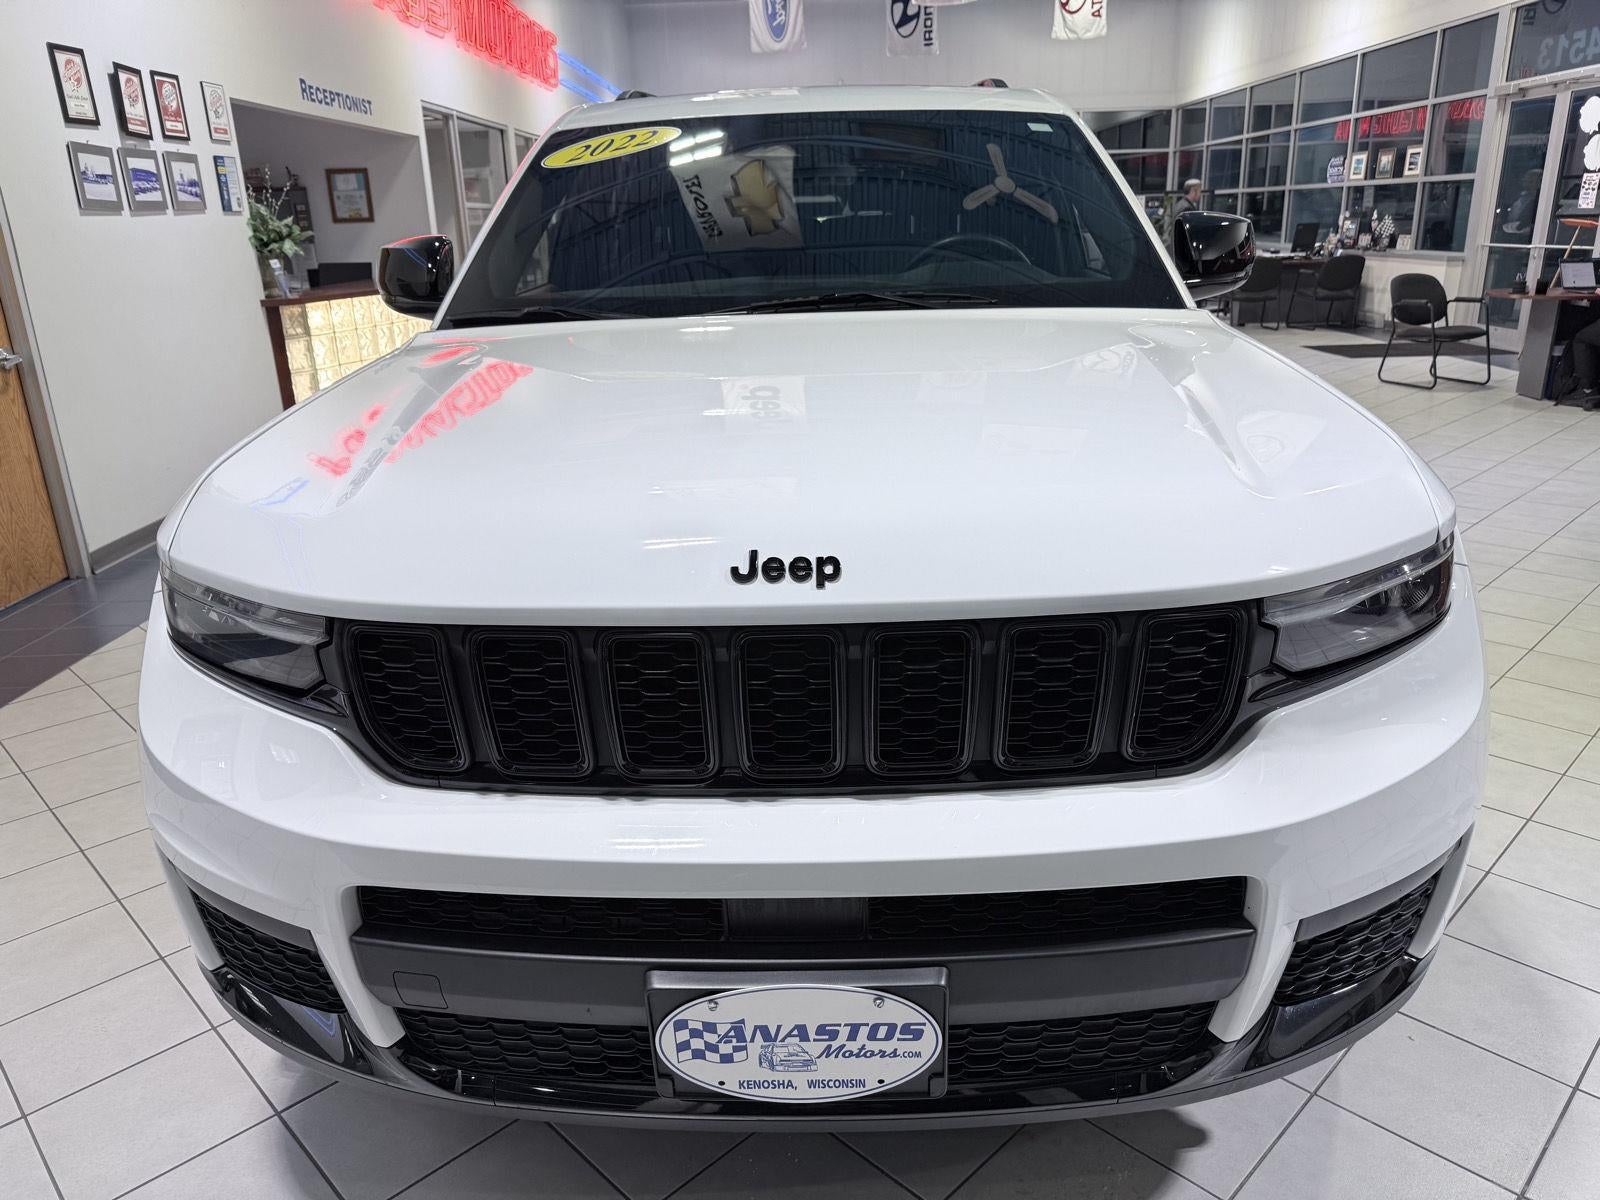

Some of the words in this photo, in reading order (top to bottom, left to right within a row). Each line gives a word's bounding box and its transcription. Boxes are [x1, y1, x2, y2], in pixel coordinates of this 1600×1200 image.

[299, 77, 373, 116] RECEPTIONIST
[564, 129, 659, 164] 2022
[730, 549, 842, 591] Jeep
[714, 1021, 927, 1044] ANASTOS
[737, 1078, 798, 1091] KENOSHA,
[806, 1078, 867, 1090] WISCONSIN
